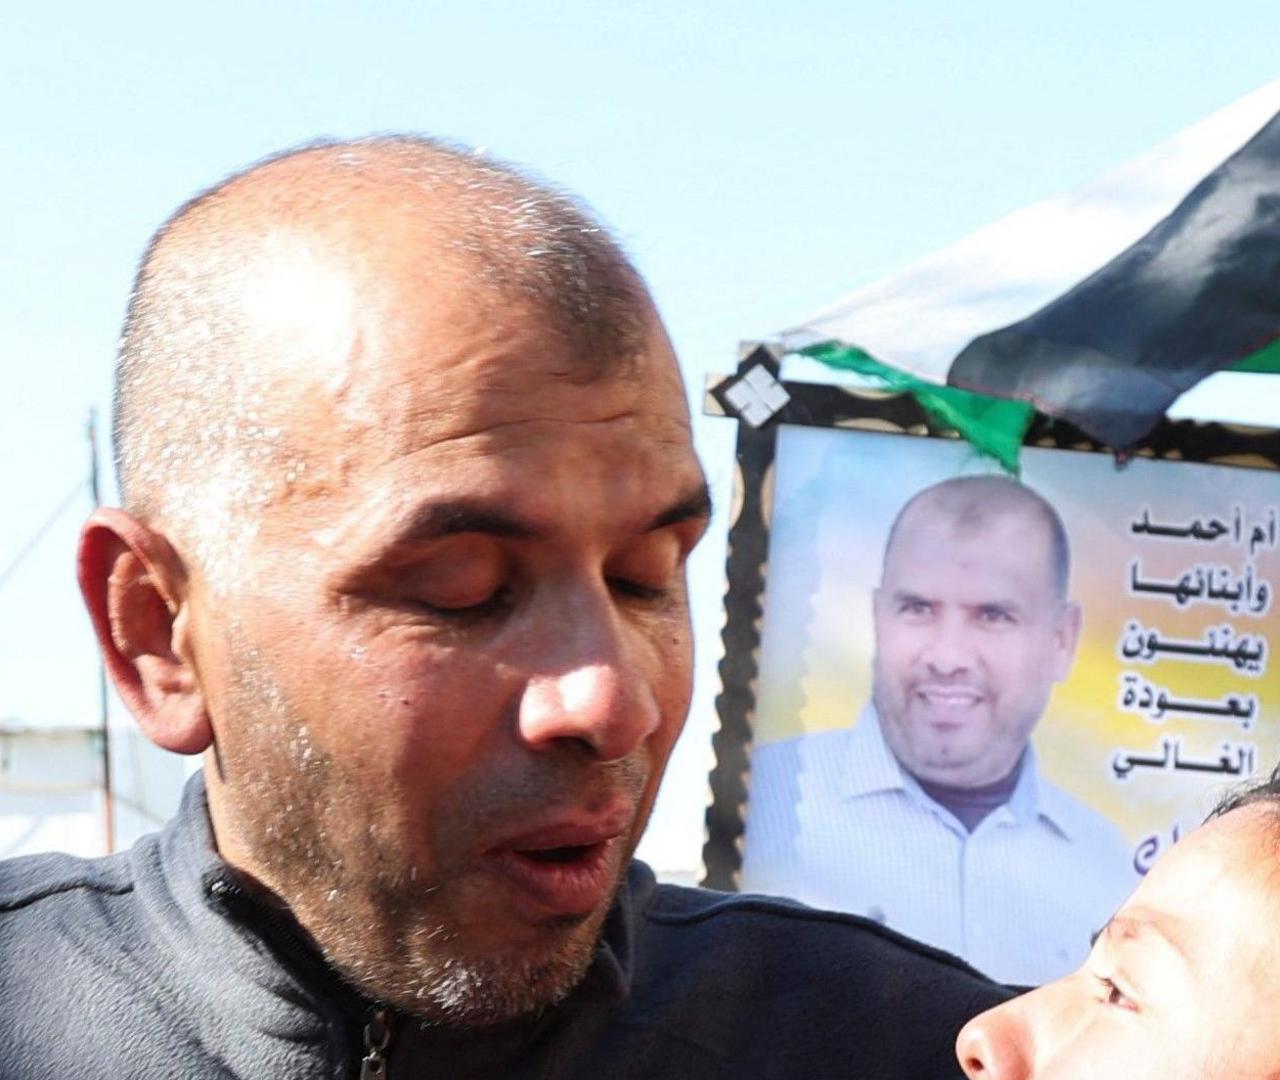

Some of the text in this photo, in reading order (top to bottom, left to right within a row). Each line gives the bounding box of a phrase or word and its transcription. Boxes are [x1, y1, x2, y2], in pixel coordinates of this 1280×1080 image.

[1130, 506, 1276, 554] أم أحمد
[1131, 562, 1269, 613] وأبنائها
[1122, 675, 1256, 729] بعودة
[1112, 740, 1254, 779] الغالي
